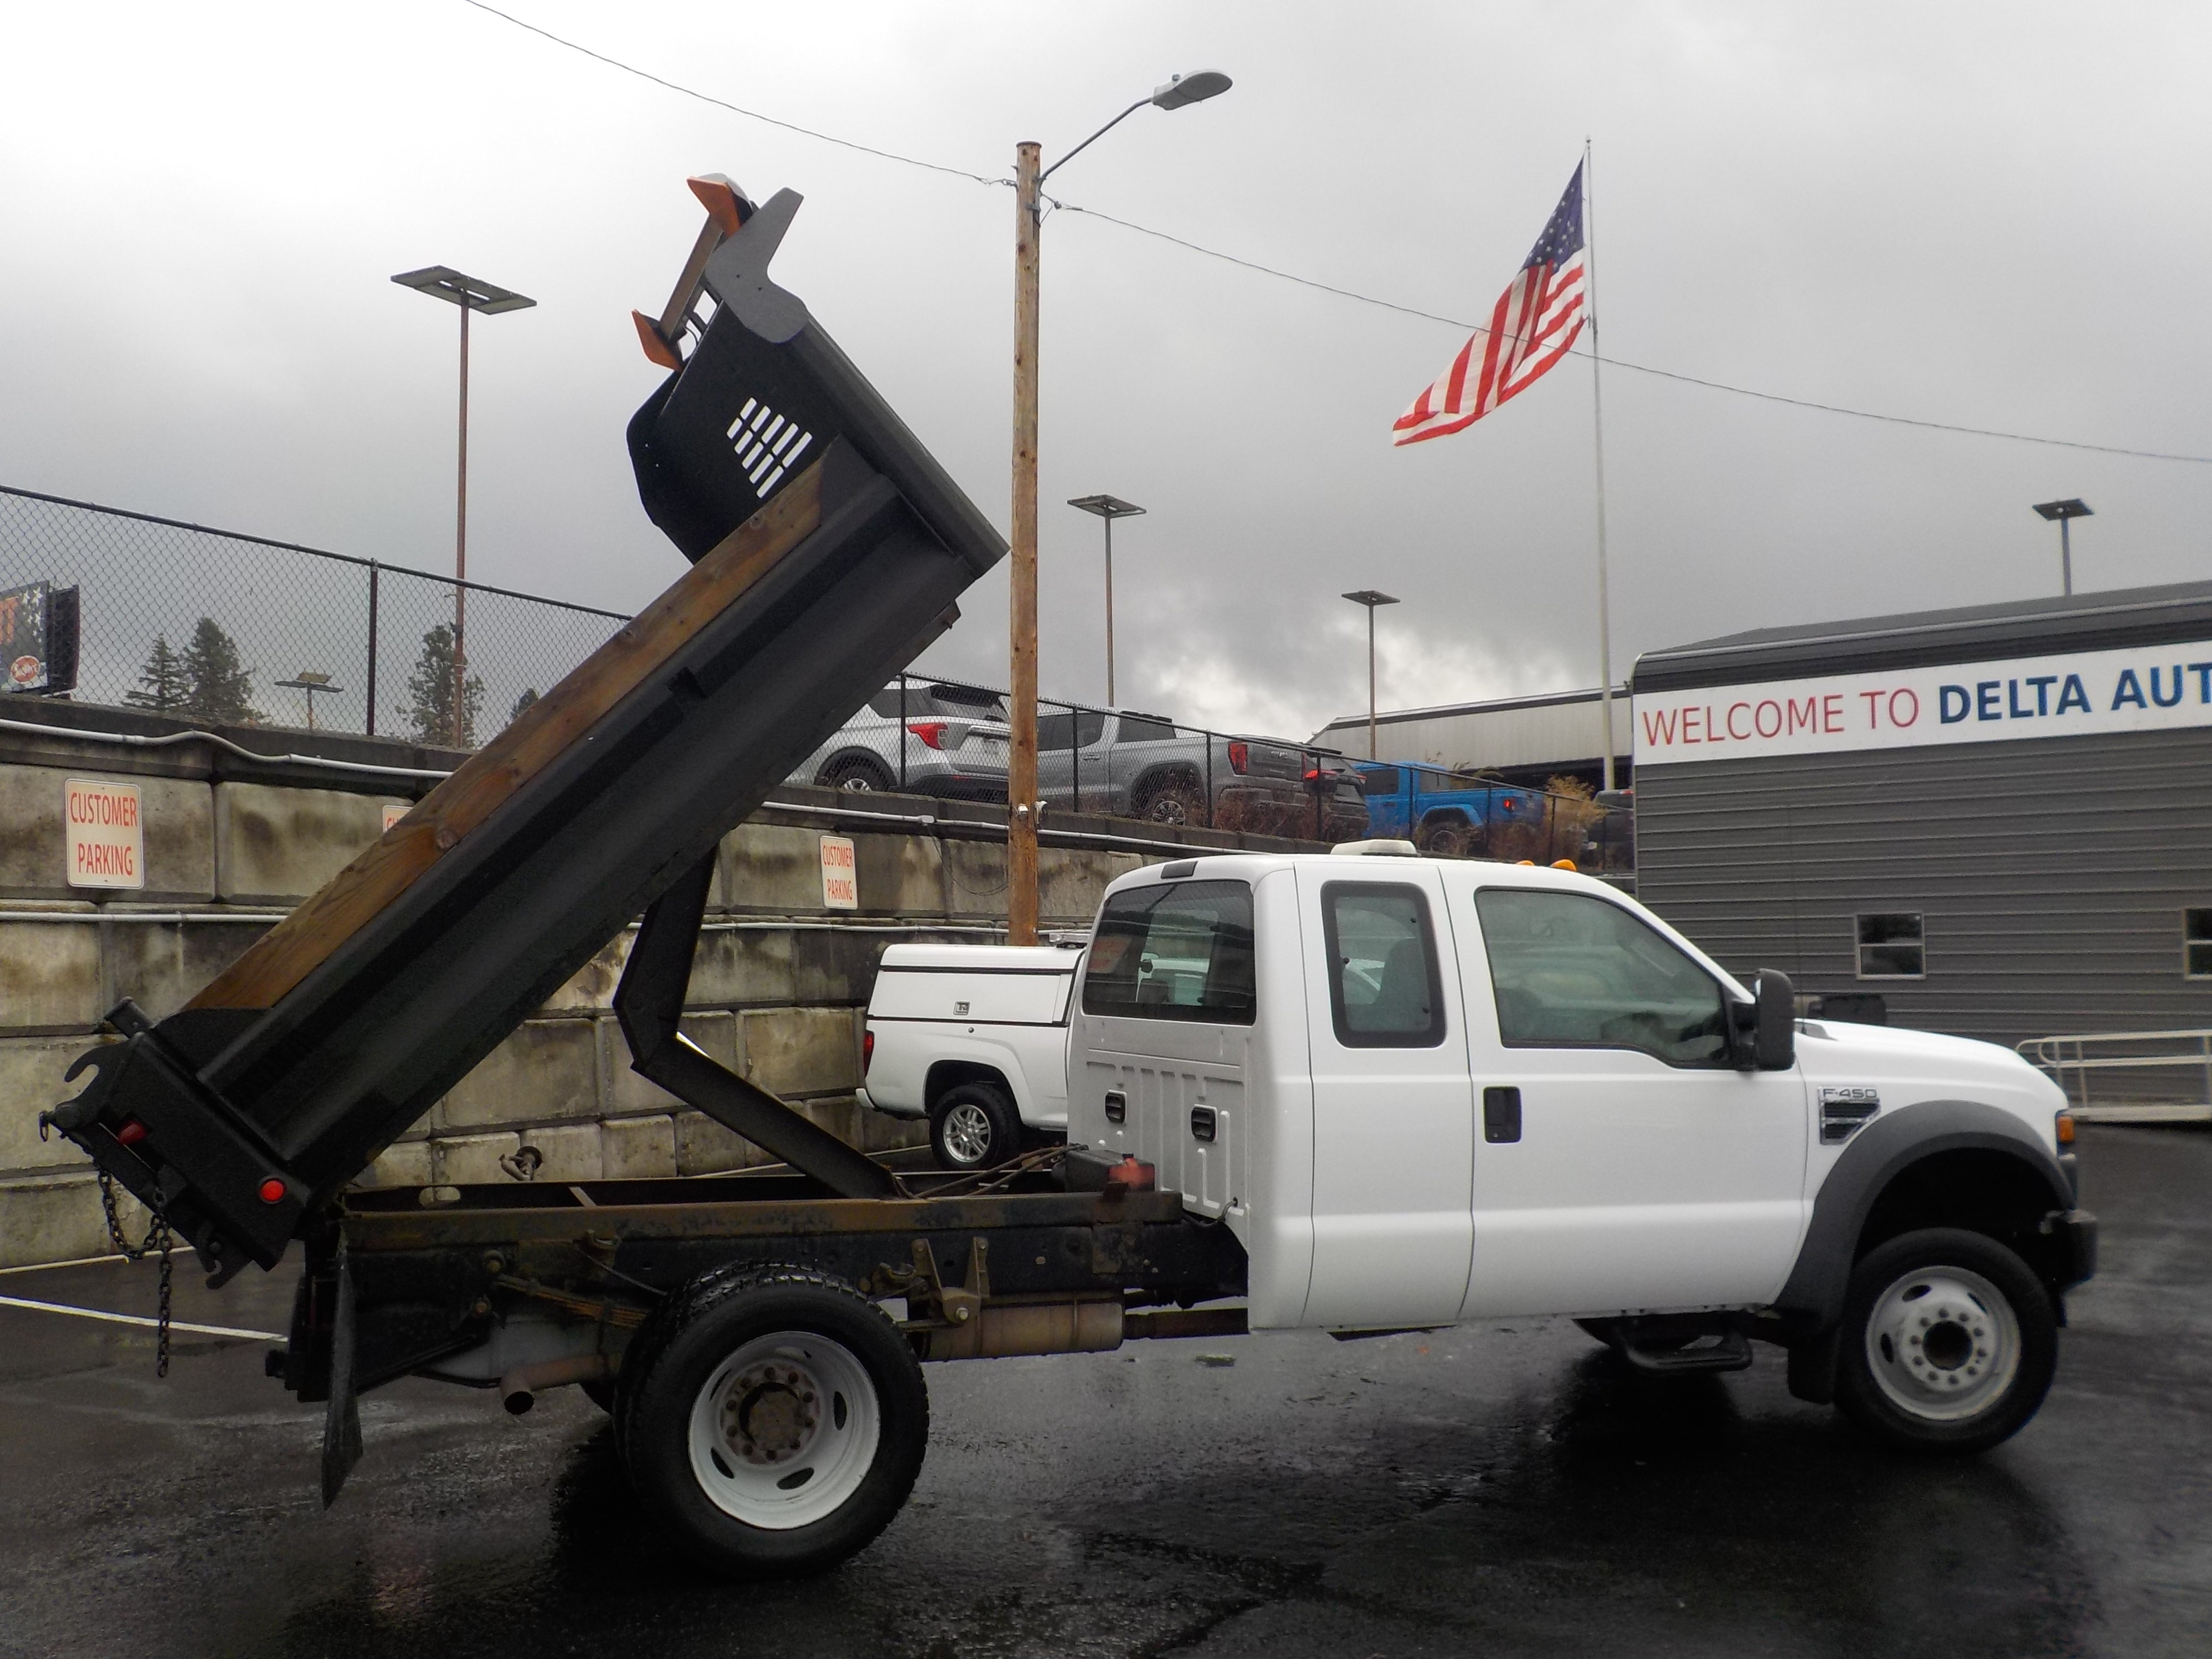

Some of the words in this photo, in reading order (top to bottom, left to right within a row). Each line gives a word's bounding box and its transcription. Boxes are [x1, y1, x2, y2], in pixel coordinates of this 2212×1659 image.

[1643, 694, 1845, 747] WELCOME
[1859, 688, 1919, 729] TO
[1939, 673, 2092, 724] DELTA
[70, 792, 137, 826] CUSTOMER
[78, 843, 132, 876] PARKING
[823, 845, 853, 867] CUSTOMER
[827, 878, 853, 900] PARKING
[1823, 1088, 1877, 1097] F-450
